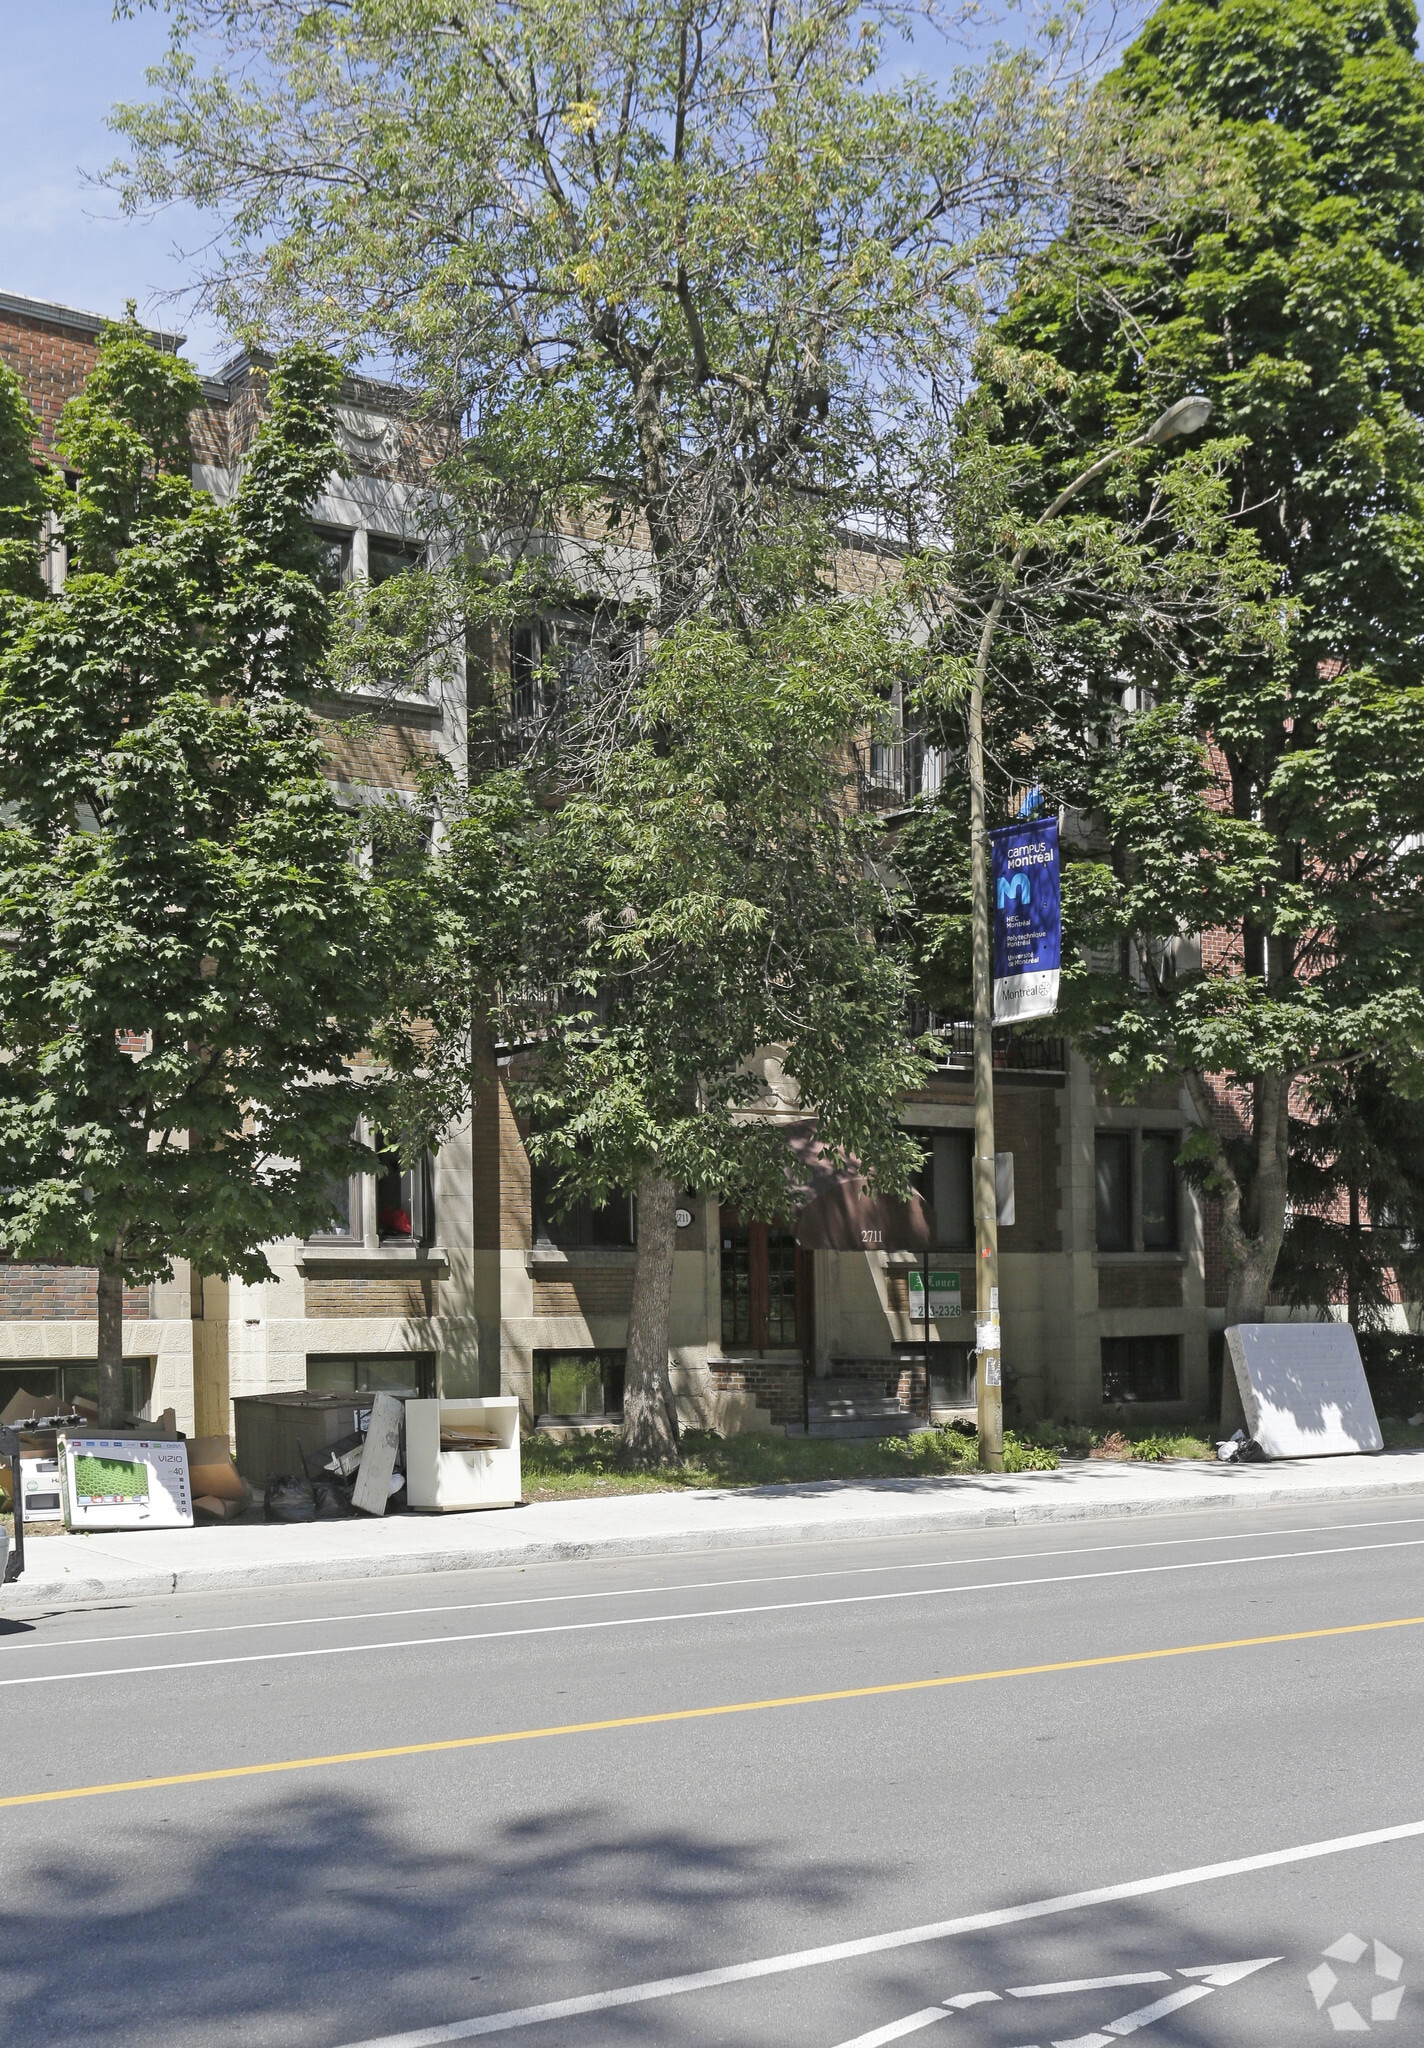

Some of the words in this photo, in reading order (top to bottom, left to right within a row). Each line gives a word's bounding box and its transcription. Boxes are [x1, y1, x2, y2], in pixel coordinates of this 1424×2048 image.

[1008, 848, 1054, 870] Montréal
[1006, 915, 1019, 923] HEC
[1006, 919, 1031, 929] Montréal
[1006, 931, 1046, 942] Polytechnique
[1006, 939, 1031, 948] Montréal
[1007, 951, 1034, 961] Université
[1014, 956, 1040, 966] Montréal
[1002, 985, 1038, 1000] Montréal
[861, 1230, 883, 1243] 2711
[918, 1305, 961, 1317] 23-2326
[157, 1455, 183, 1463] VIZIO
[173, 1467, 183, 1476] 40
